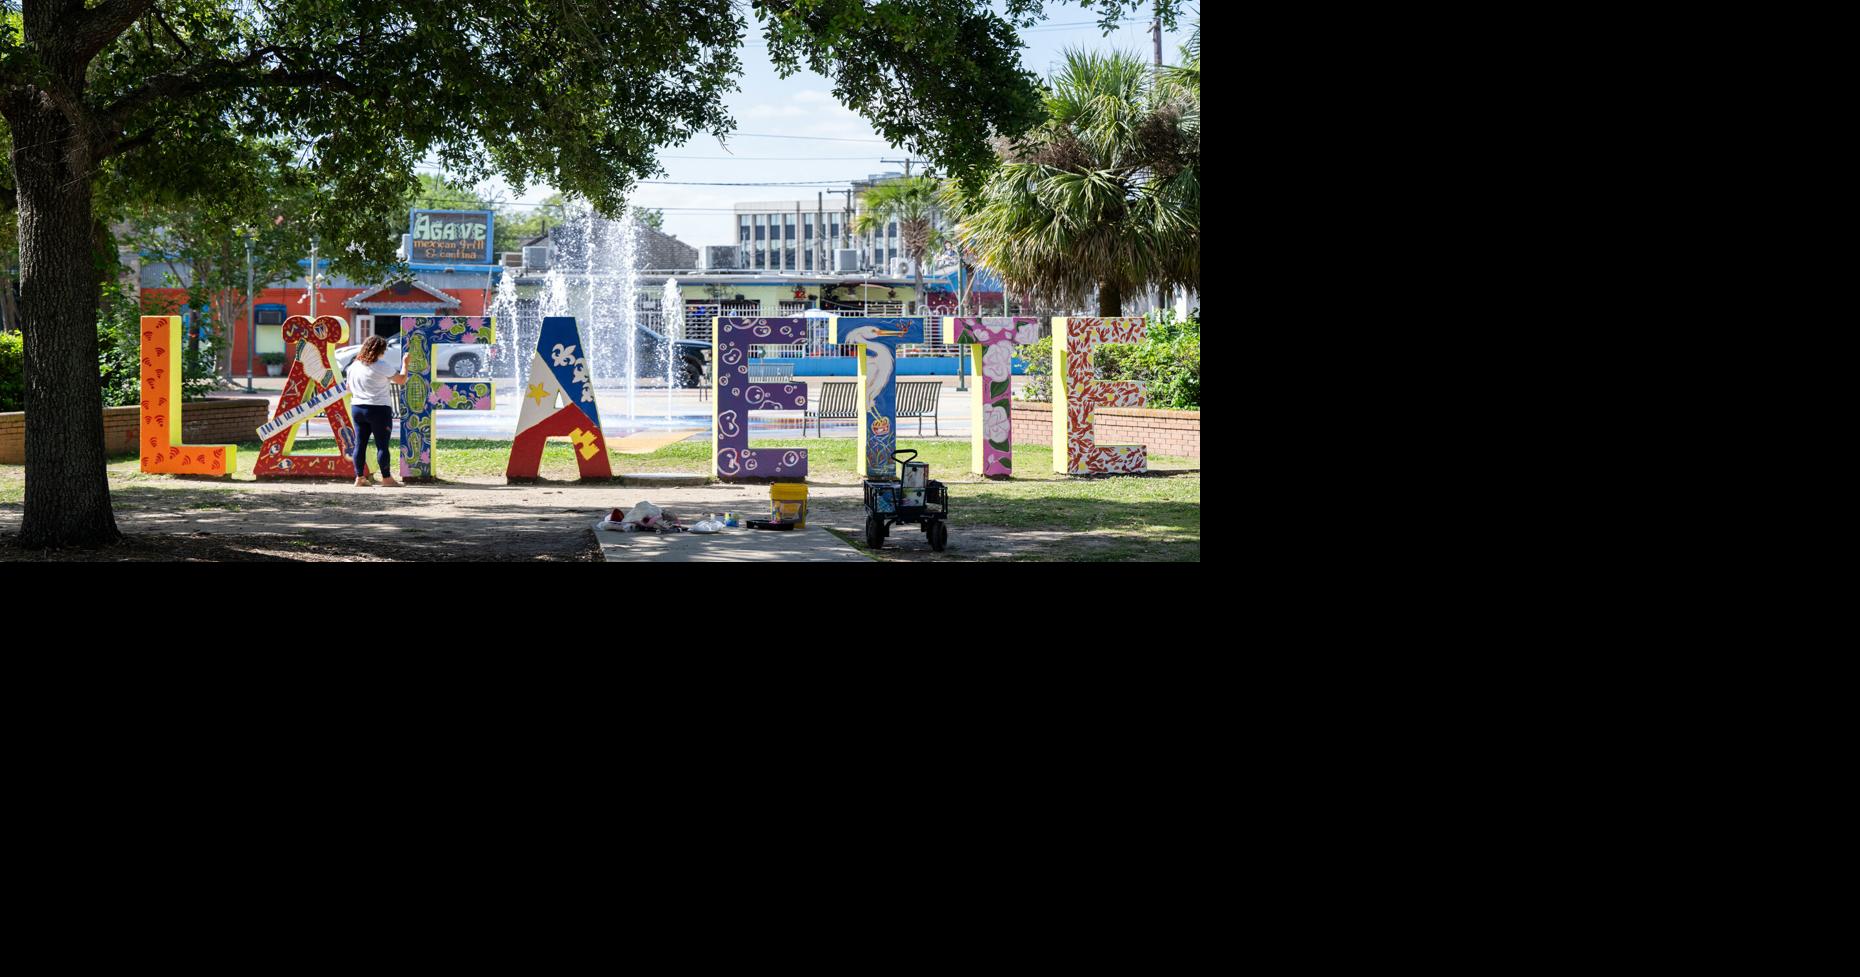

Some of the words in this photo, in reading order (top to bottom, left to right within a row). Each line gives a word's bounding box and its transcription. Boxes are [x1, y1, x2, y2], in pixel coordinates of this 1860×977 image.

[413, 213, 487, 240] AGAVE
[414, 240, 456, 249] mexican
[460, 240, 484, 250] grill
[425, 248, 437, 258] &
[439, 249, 477, 259] cantina
